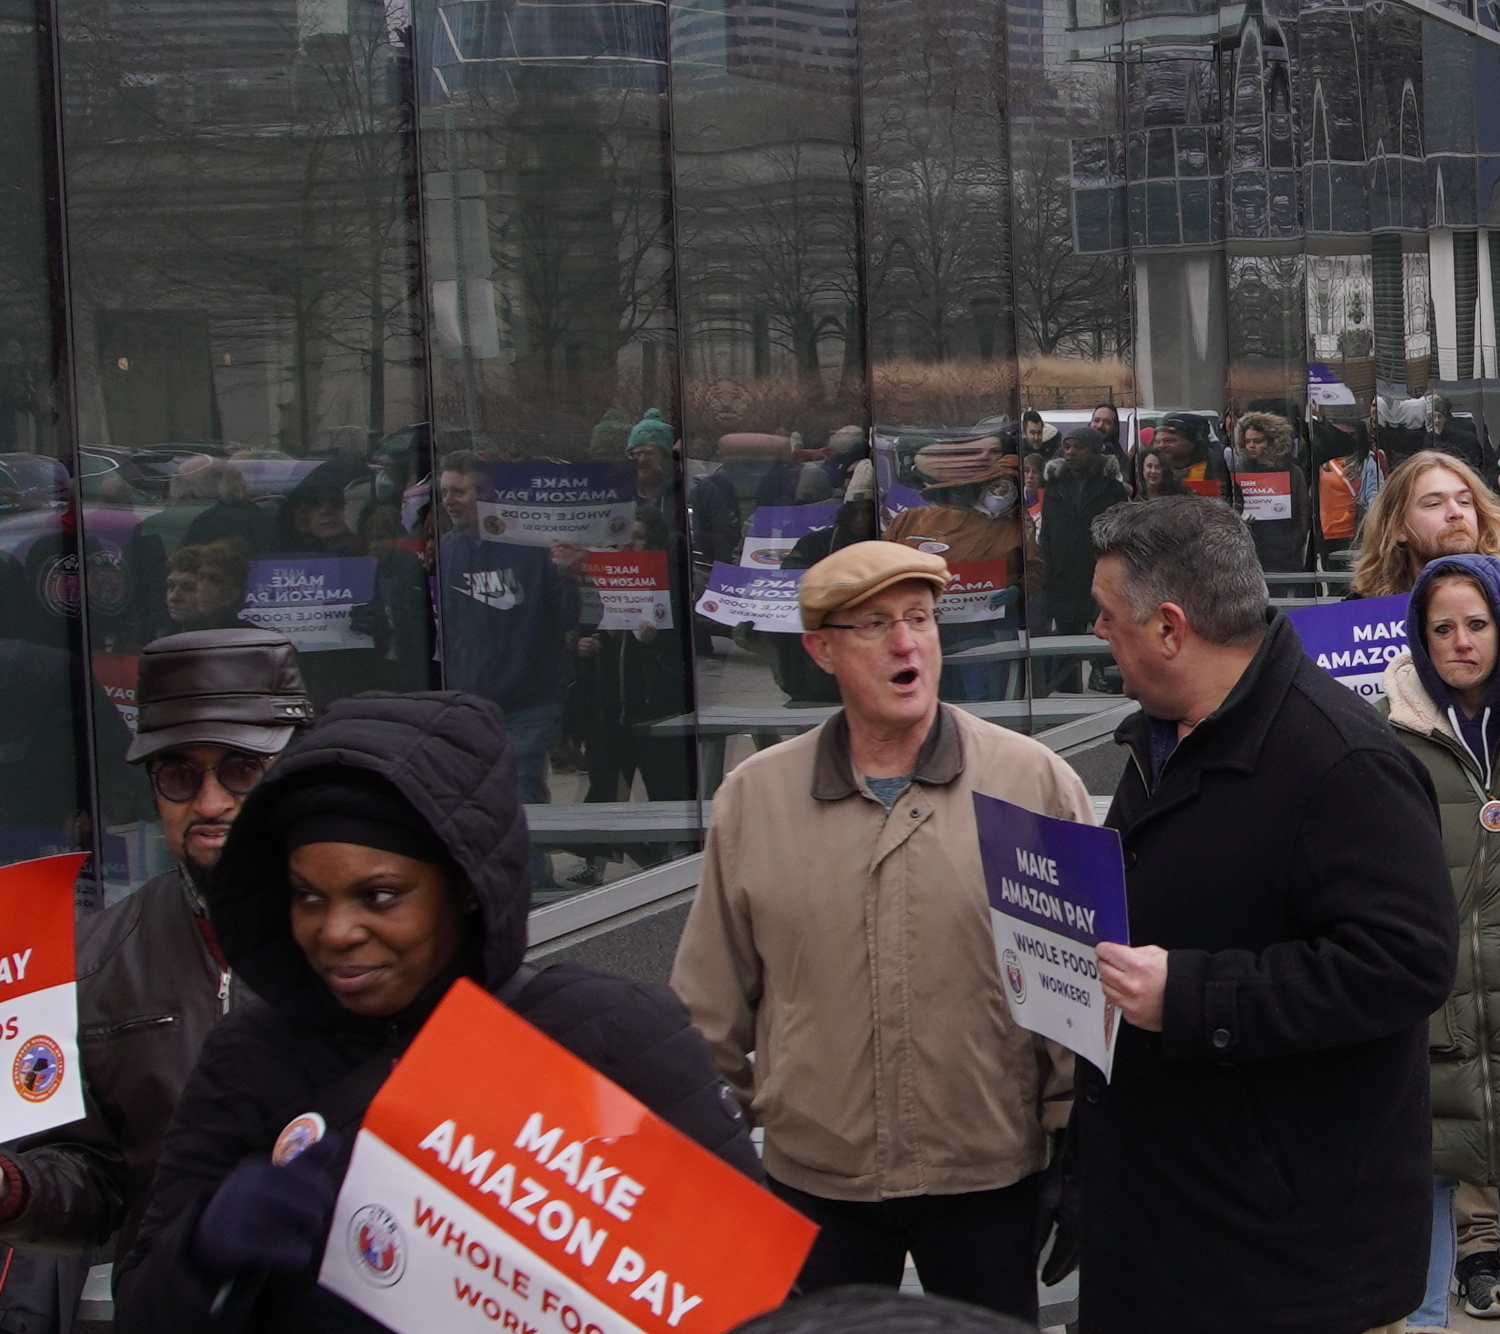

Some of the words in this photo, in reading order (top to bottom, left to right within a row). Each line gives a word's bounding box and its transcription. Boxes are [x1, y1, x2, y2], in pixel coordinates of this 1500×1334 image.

[1353, 619, 1408, 643] MAK
[1015, 847, 1060, 886] MAKE
[1001, 876, 1064, 924] AMAZON
[1066, 901, 1096, 935] PAY
[1013, 931, 1060, 966] WHOLE
[1063, 949, 1103, 982] FOOD
[1038, 972, 1091, 1009] WORKERS!
[513, 1112, 647, 1223] MAKE
[414, 1195, 531, 1300] WHOLE
[418, 1118, 609, 1267] AMAZON
[606, 1246, 703, 1328] PAY
